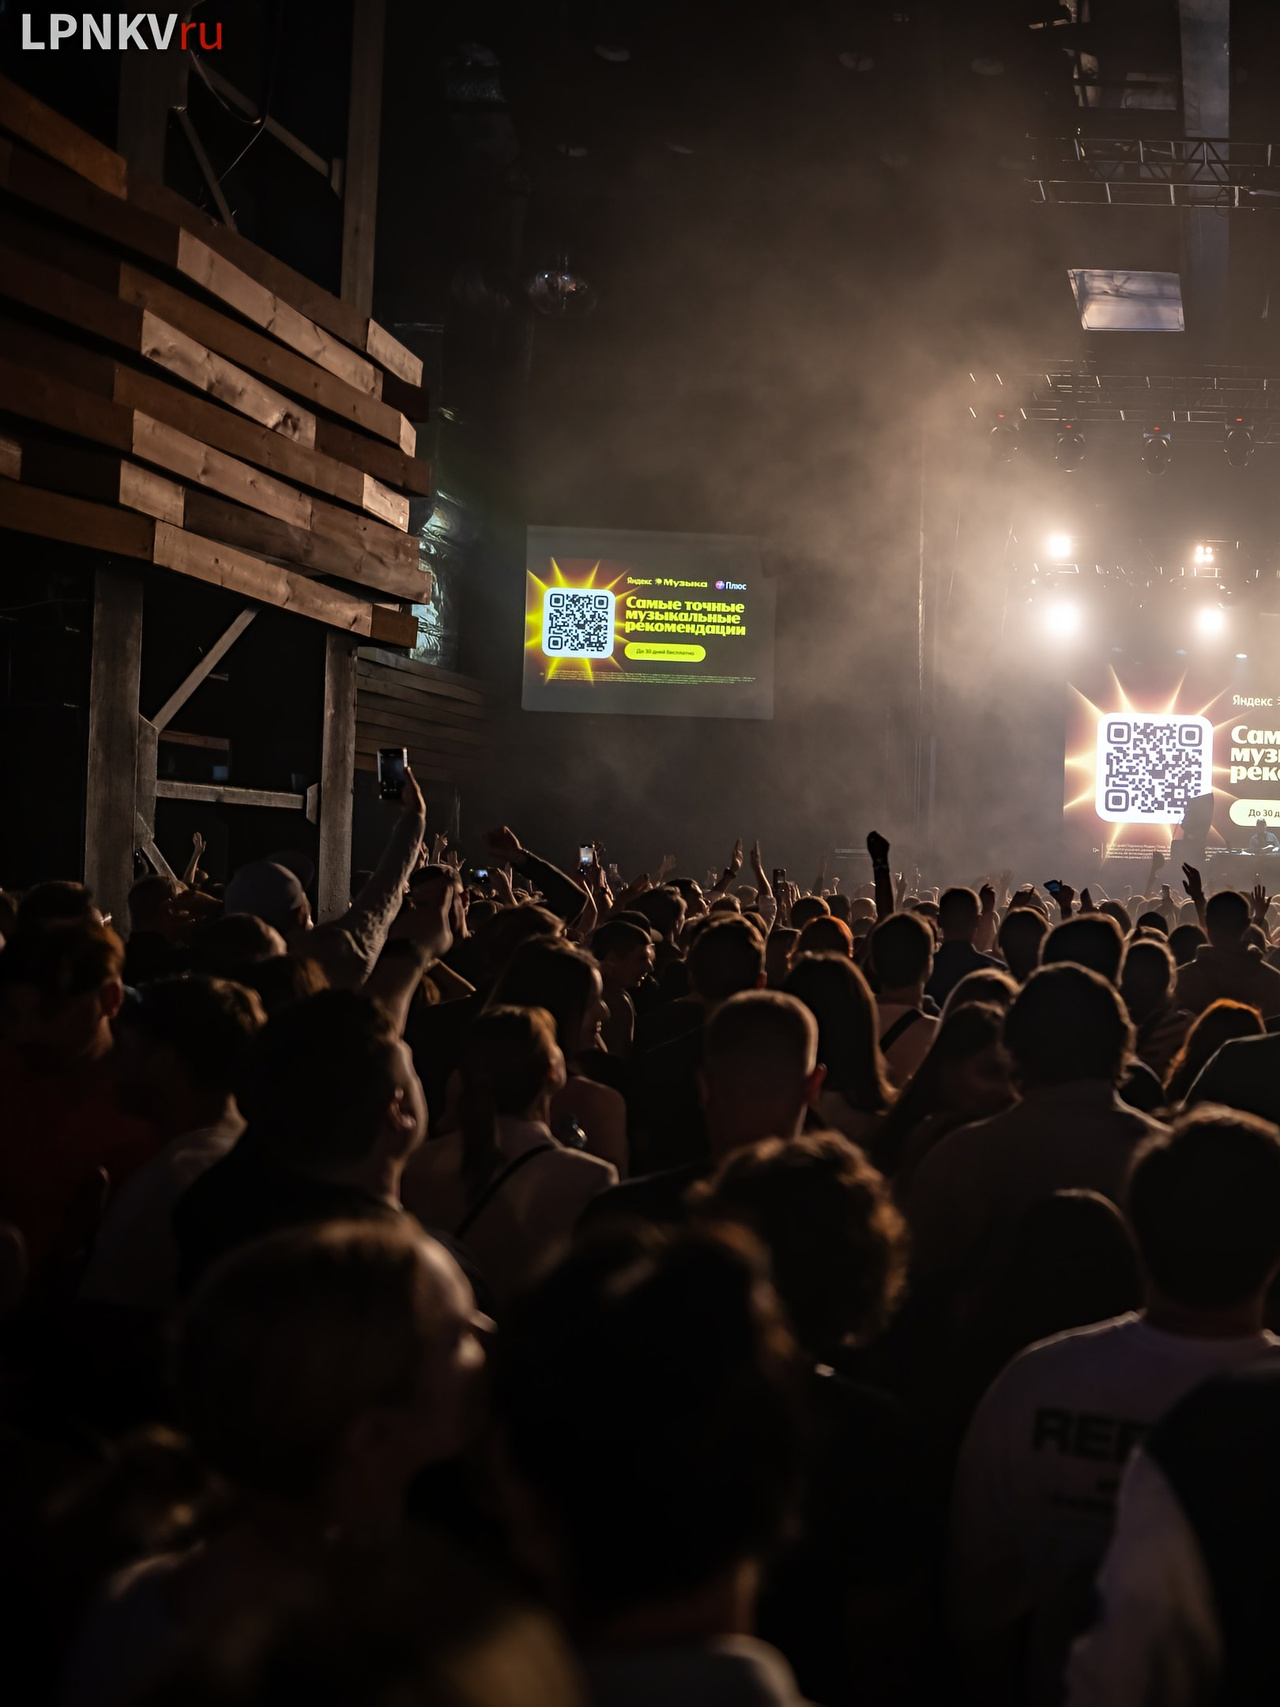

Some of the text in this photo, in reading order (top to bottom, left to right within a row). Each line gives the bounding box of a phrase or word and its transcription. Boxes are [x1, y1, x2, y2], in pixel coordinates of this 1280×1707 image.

[627, 577, 747, 590] Яндекс Музыка Плюс
[626, 596, 745, 613] Самые точные
[625, 609, 741, 624] музыкальные
[625, 621, 746, 636] рекомендации
[1232, 694, 1273, 707] Яндекс
[1248, 809, 1261, 818] До
[1262, 809, 1273, 817] 30
